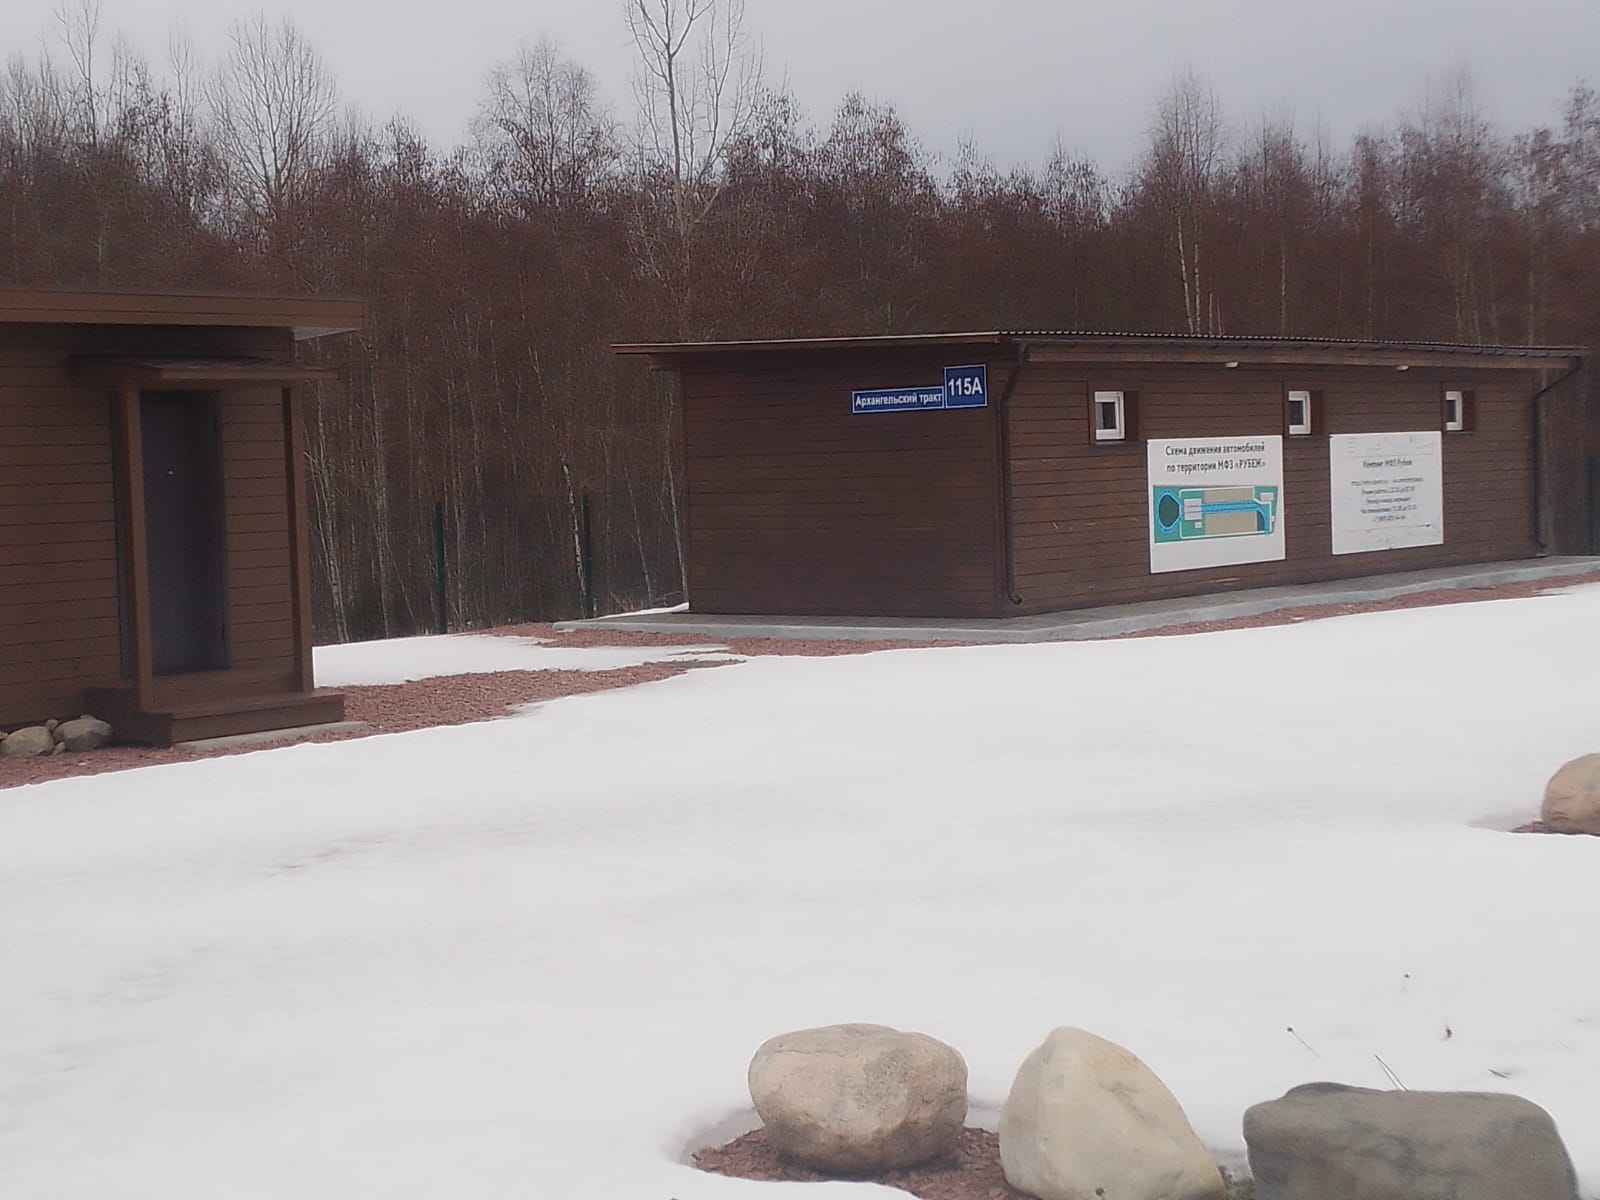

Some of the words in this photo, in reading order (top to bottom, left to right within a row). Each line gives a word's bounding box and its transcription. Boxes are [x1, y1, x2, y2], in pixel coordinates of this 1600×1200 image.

[855, 392, 917, 409] Архангельский
[919, 392, 942, 405] тракт
[1165, 445, 1187, 456] Схема
[1188, 446, 1221, 456] движения
[1223, 441, 1265, 454] автомобилей
[1166, 464, 1176, 472] по
[1177, 462, 1217, 474] территории
[1217, 459, 1234, 470] МФЗ
